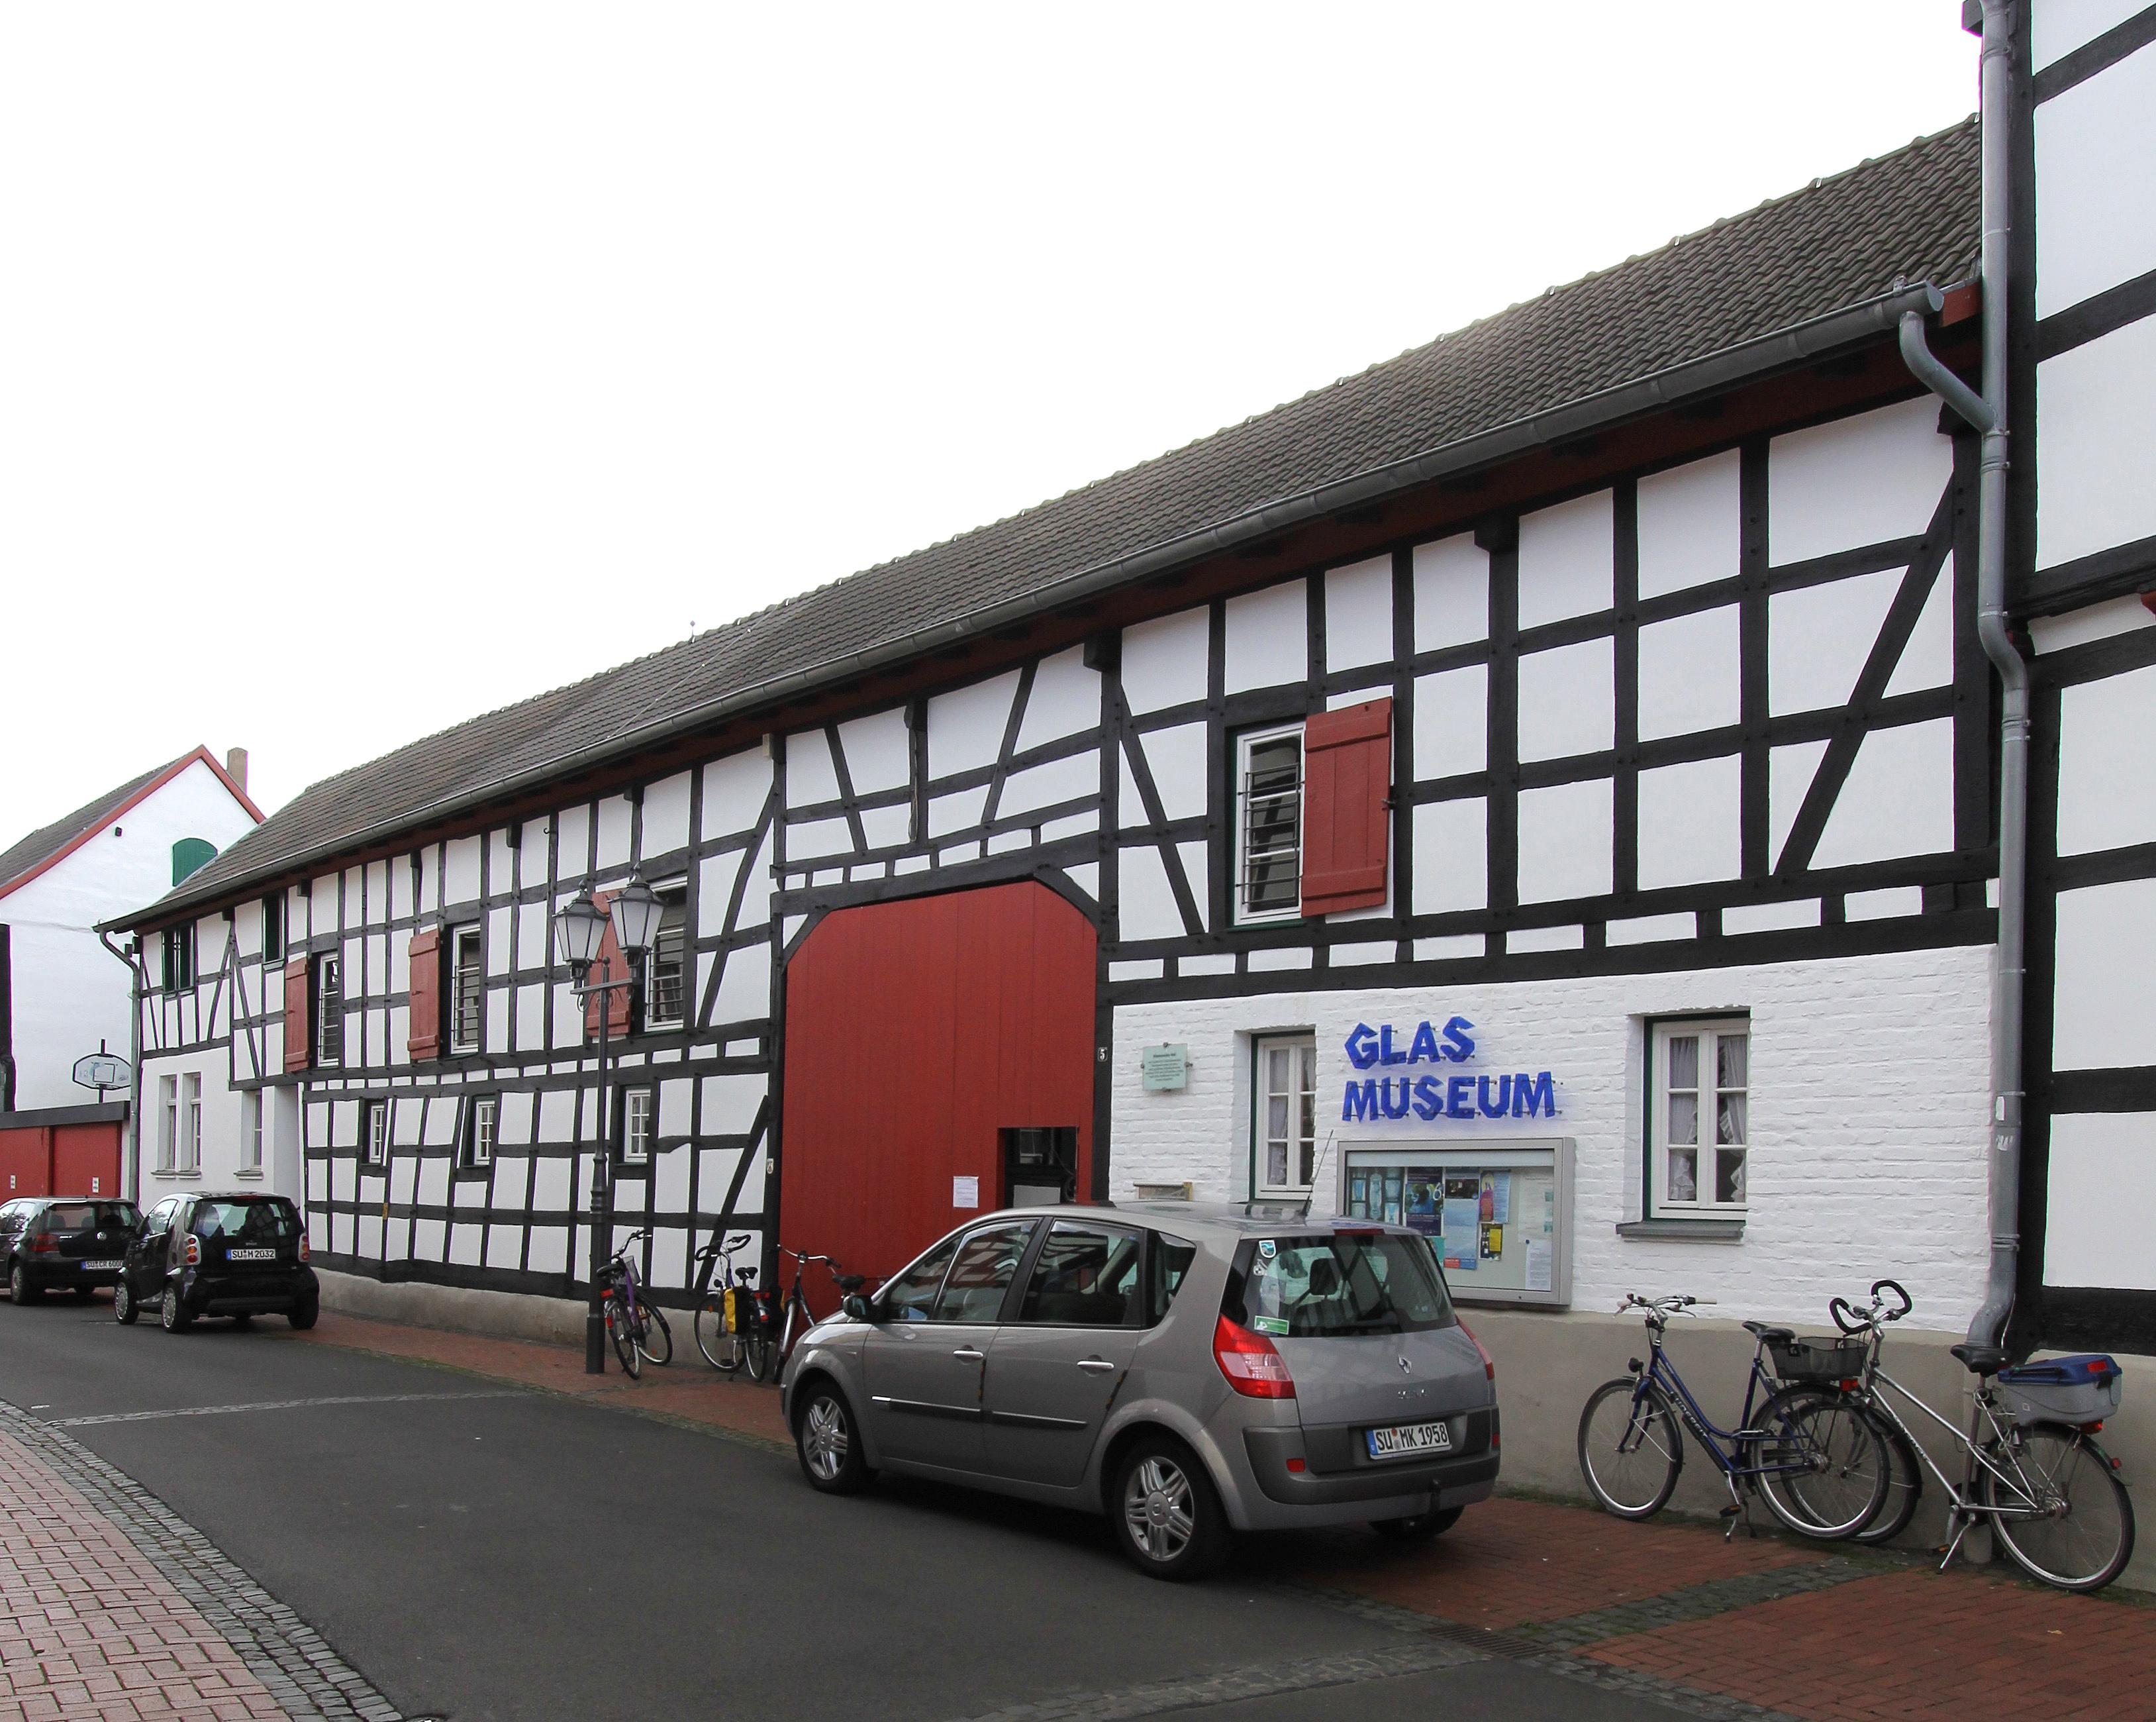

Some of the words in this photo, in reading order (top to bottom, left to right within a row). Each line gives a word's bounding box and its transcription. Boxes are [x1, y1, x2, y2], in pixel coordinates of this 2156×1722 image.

[1099, 1048, 1105, 1060] 5
[1344, 1016, 1475, 1069] GLAS
[1342, 1071, 1555, 1123] MUSEUM
[232, 1250, 243, 1258] SU
[1375, 1431, 1394, 1450] SU
[1399, 1427, 1417, 1448] MK
[1418, 1425, 1448, 1445] 1958
